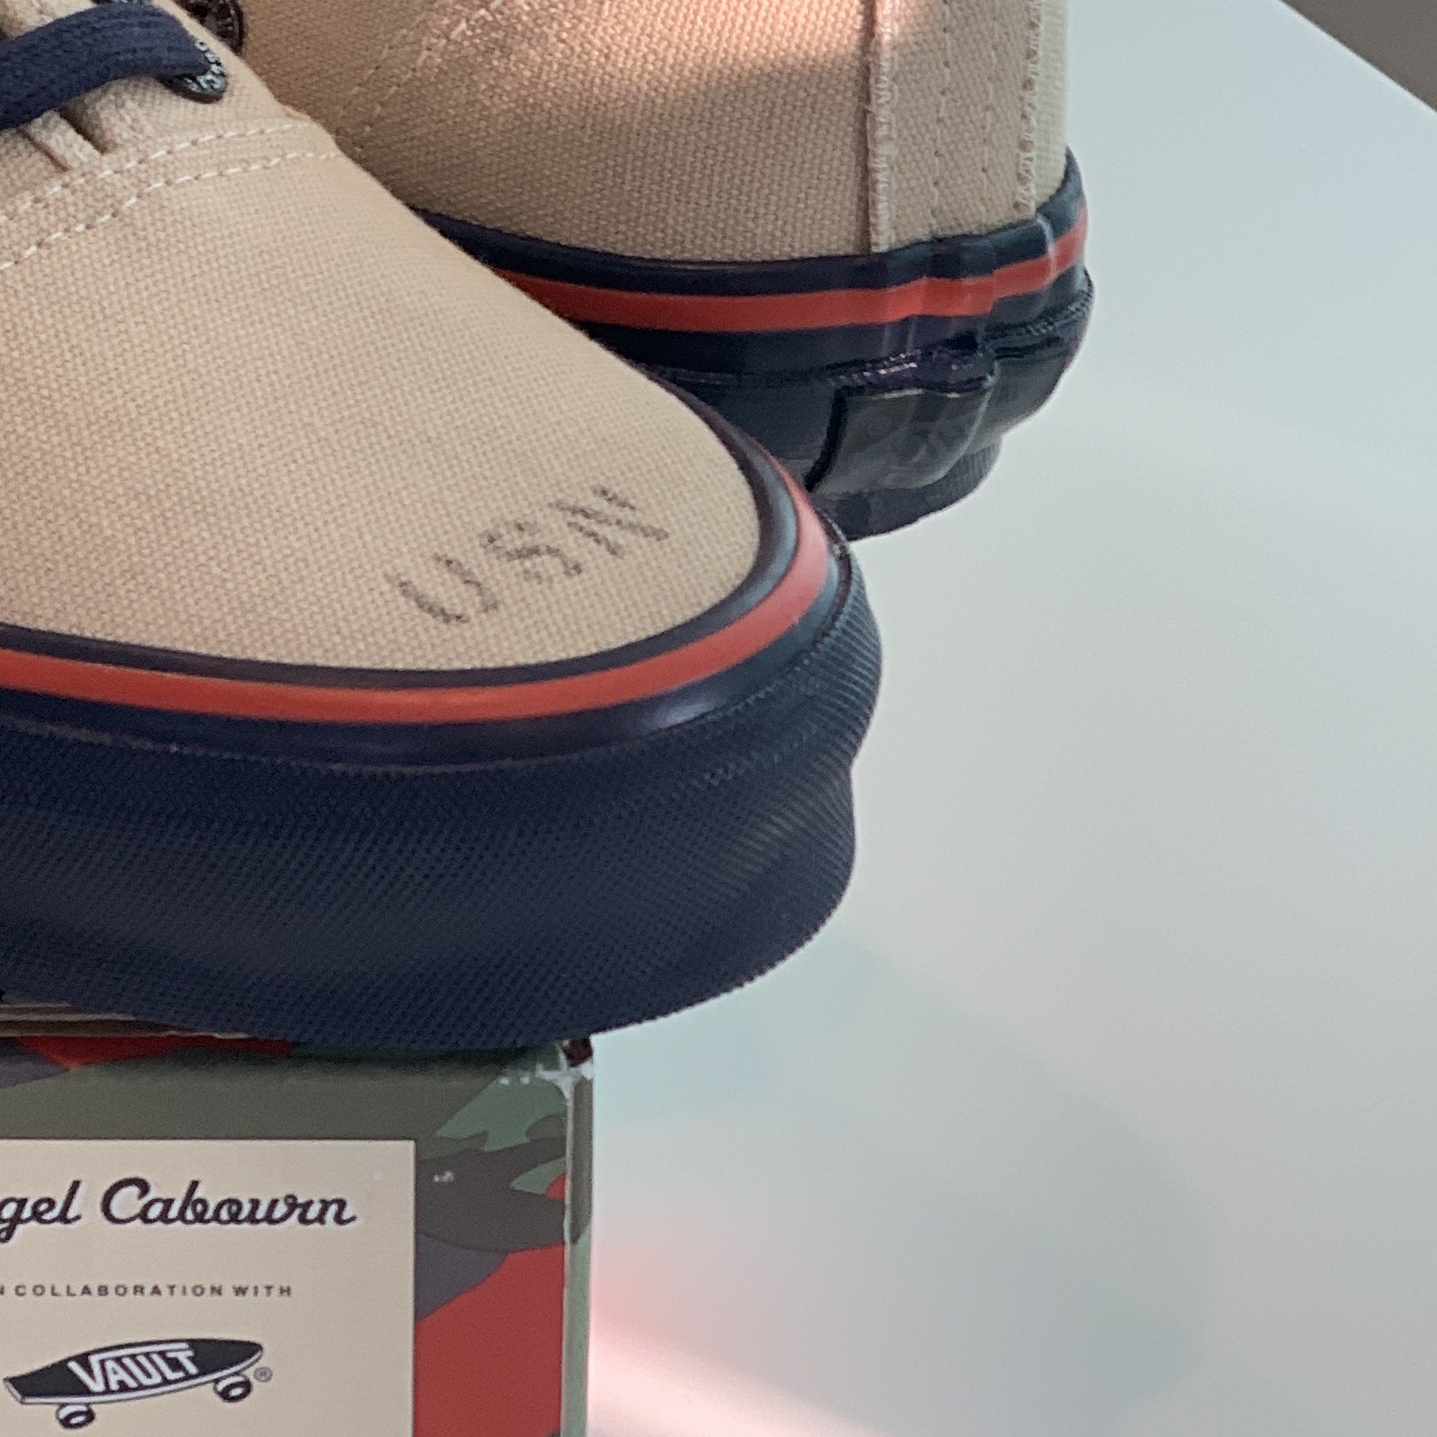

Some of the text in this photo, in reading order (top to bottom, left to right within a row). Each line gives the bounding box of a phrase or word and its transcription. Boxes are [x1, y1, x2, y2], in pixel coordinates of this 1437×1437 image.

[382, 483, 670, 625] USN
[100, 1176, 358, 1227] Cabourn
[14, 1283, 224, 1298] COLLABORATION
[232, 1283, 294, 1298] WITH
[66, 1342, 201, 1394] VAULT
